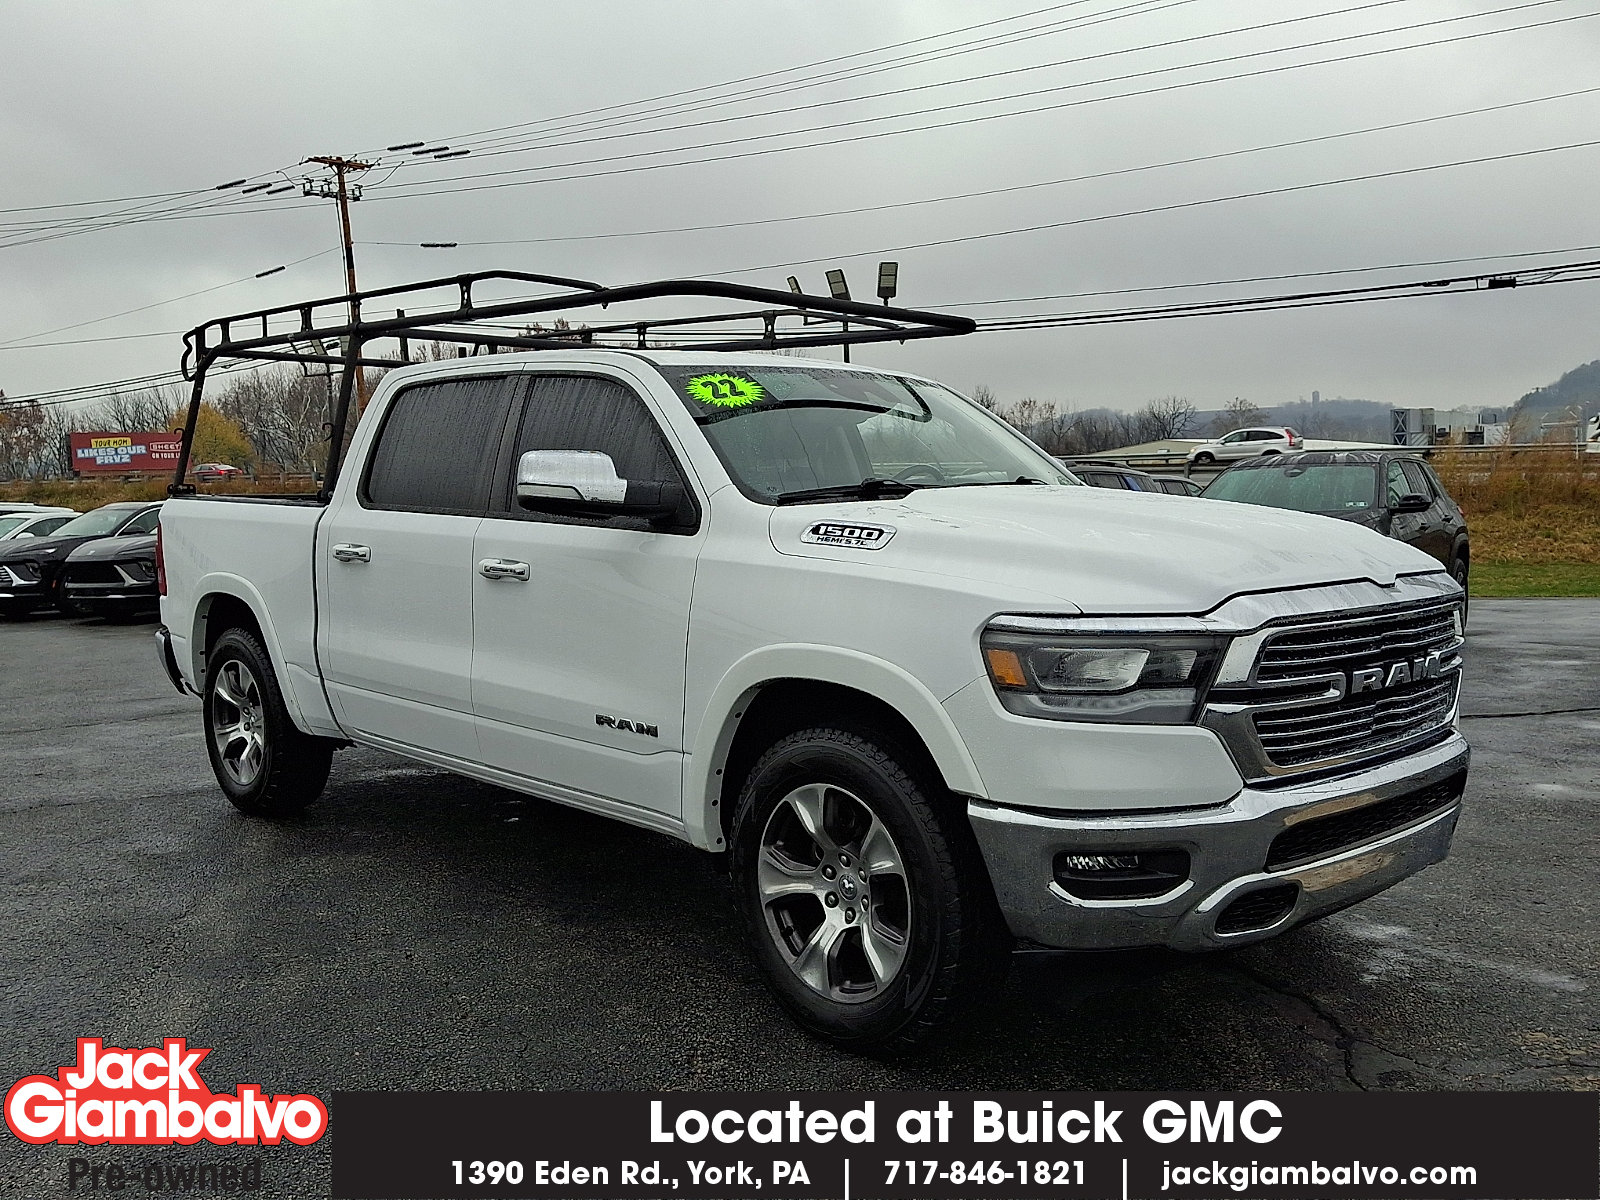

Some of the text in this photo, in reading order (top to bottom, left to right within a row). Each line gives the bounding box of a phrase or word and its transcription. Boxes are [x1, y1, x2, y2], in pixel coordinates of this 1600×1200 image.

[700, 379, 746, 399] 22
[77, 445, 146, 458] LIKES OUR
[96, 454, 131, 465] FRYZ
[818, 525, 880, 540] 1500
[816, 536, 867, 546] HEMI 5.7L
[1351, 652, 1442, 694] RAM
[594, 713, 659, 738] RAM
